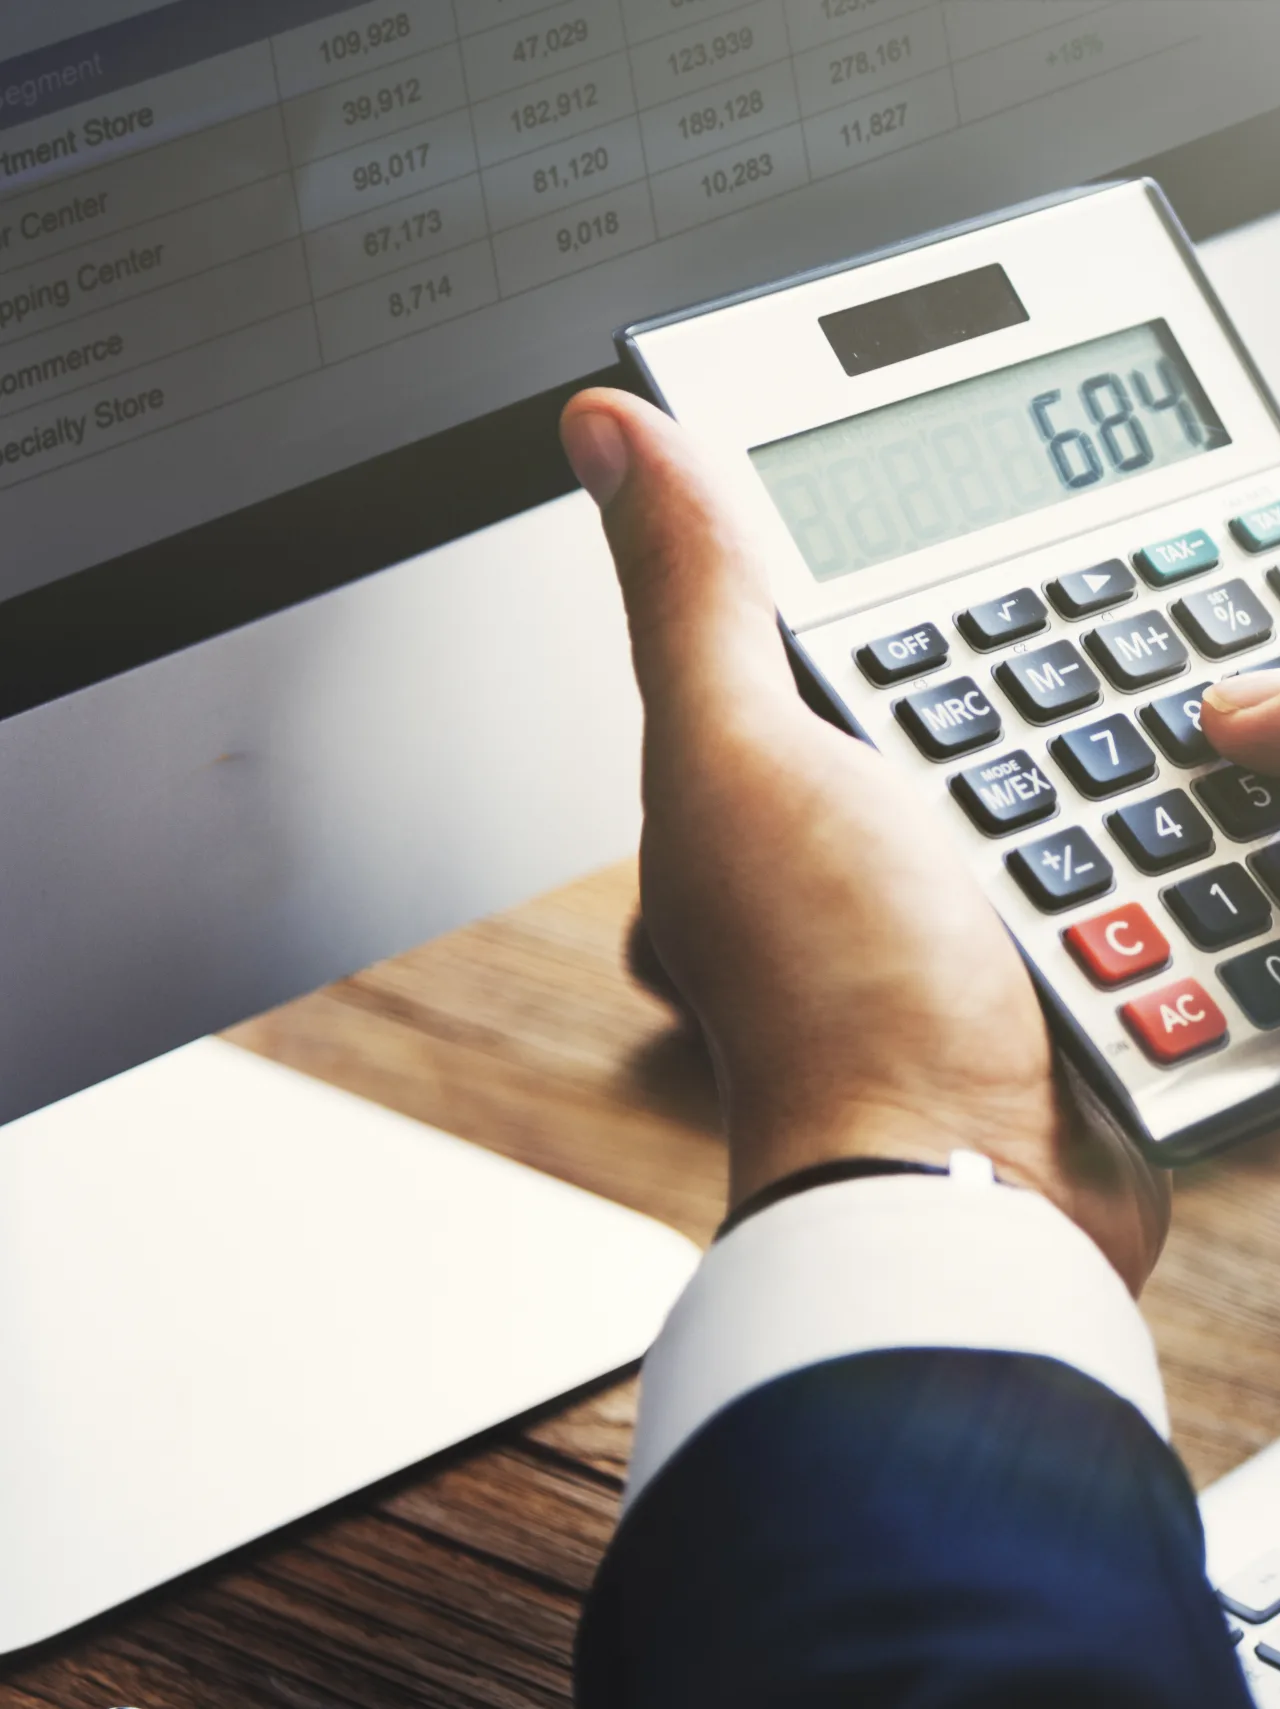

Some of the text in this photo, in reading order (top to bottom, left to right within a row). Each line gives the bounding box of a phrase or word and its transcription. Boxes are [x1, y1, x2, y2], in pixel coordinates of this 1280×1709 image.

[318, 12, 411, 65] 109,928
[512, 18, 589, 62] 47,029
[667, 26, 754, 76] 123,939
[829, 34, 912, 85] 278,161
[0, 52, 103, 109] egment
[342, 77, 422, 126] 39,912
[510, 82, 599, 134] 182,912
[677, 89, 764, 140] 189,128
[839, 102, 908, 148] 11,827
[0, 106, 154, 176] tment Store
[352, 142, 430, 191] 98,017
[532, 146, 609, 194] 81,120
[701, 153, 774, 199] 10,283
[20, 191, 108, 240] Center
[363, 208, 443, 257] 67,173
[556, 210, 620, 253] 9,018
[76, 243, 166, 292] Center
[387, 274, 452, 318] 8,714
[0, 332, 124, 398] ommerce
[94, 387, 165, 430] Store
[1029, 355, 1206, 490] 684
[1155, 539, 1205, 563] TAX-
[1206, 588, 1230, 605] SET
[887, 631, 931, 660] OFF
[1114, 626, 1169, 662] M+
[1025, 662, 1080, 694] M-
[922, 691, 990, 731] MRC
[1089, 729, 1120, 766] 7
[978, 767, 1051, 810] M/EX
[980, 759, 1021, 782] MODE
[1238, 775, 1272, 807] 5
[1155, 806, 1183, 838] 4
[1209, 882, 1238, 915] 1
[1105, 921, 1144, 956] C
[1159, 994, 1205, 1033] AC
